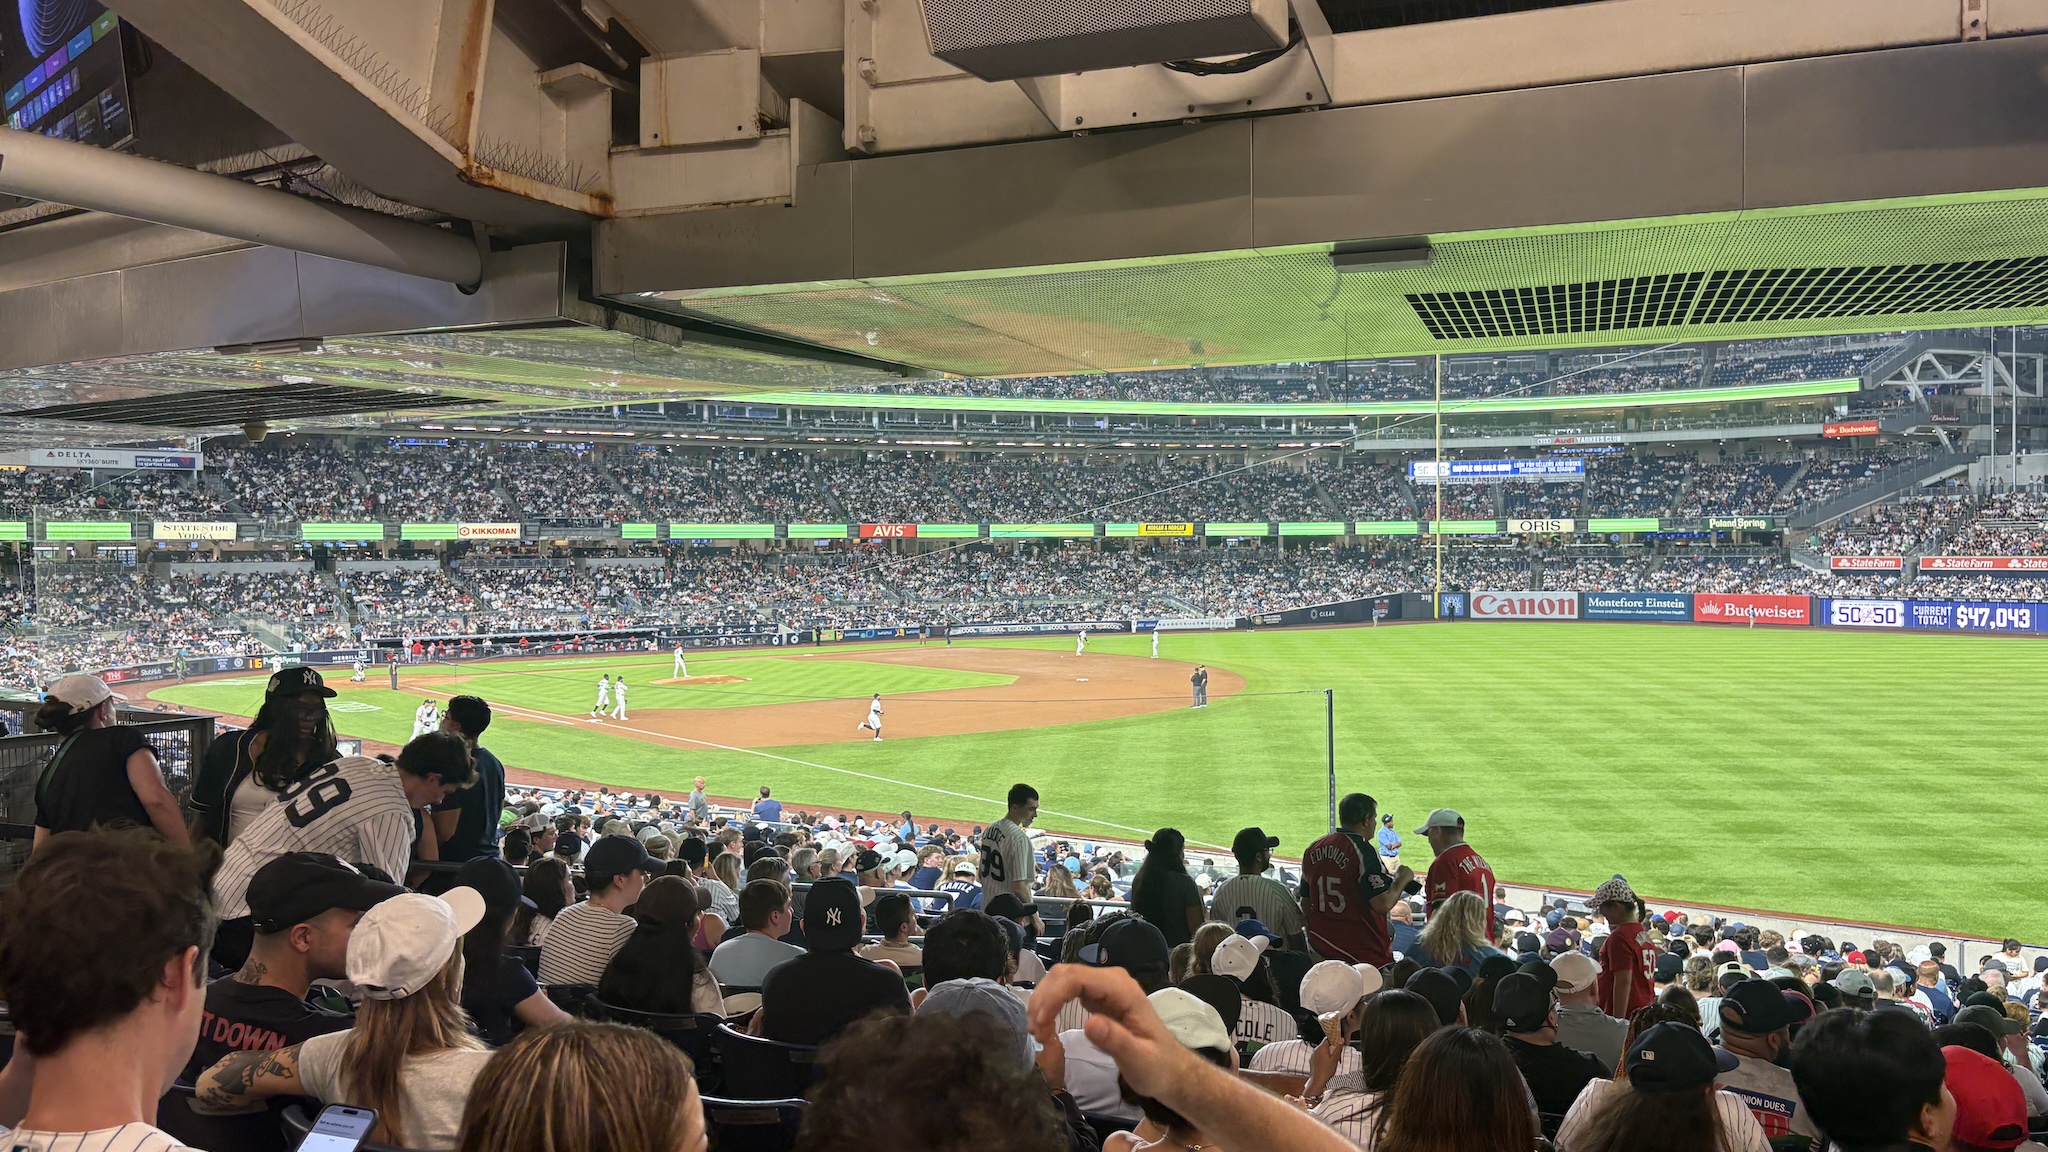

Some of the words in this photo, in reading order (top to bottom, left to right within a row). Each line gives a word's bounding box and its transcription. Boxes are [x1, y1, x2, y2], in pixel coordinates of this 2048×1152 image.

[1839, 424, 1877, 434] Budweiser
[1605, 435, 1622, 443] CLUB
[58, 451, 91, 459] DELTA
[1520, 520, 1561, 532] ORIS
[1709, 518, 1737, 529] Poland
[1737, 518, 1766, 529] Spring
[178, 532, 214, 540] VODKA
[471, 527, 517, 535] KIKKOMAN
[872, 525, 904, 537] AVIS
[1472, 594, 1576, 616] Canon
[1588, 597, 1644, 608] Montefiore
[1645, 597, 1685, 609] Einstein
[1838, 606, 1861, 623] 50
[1873, 607, 1897, 624] 50
[1913, 605, 1952, 616] CURRENT
[1917, 614, 1948, 626] TOTAL:
[1956, 604, 2031, 630] $47,043
[302, 670, 317, 685] NY
[1309, 844, 1350, 870] EDMONDS
[1458, 856, 1476, 875] THE
[940, 881, 975, 893] MANTLE
[1316, 875, 1346, 914] 15
[826, 907, 842, 926] NY
[1642, 948, 1656, 980] 50
[212, 1016, 287, 1051] DOWN
[1235, 1019, 1275, 1042] COLE
